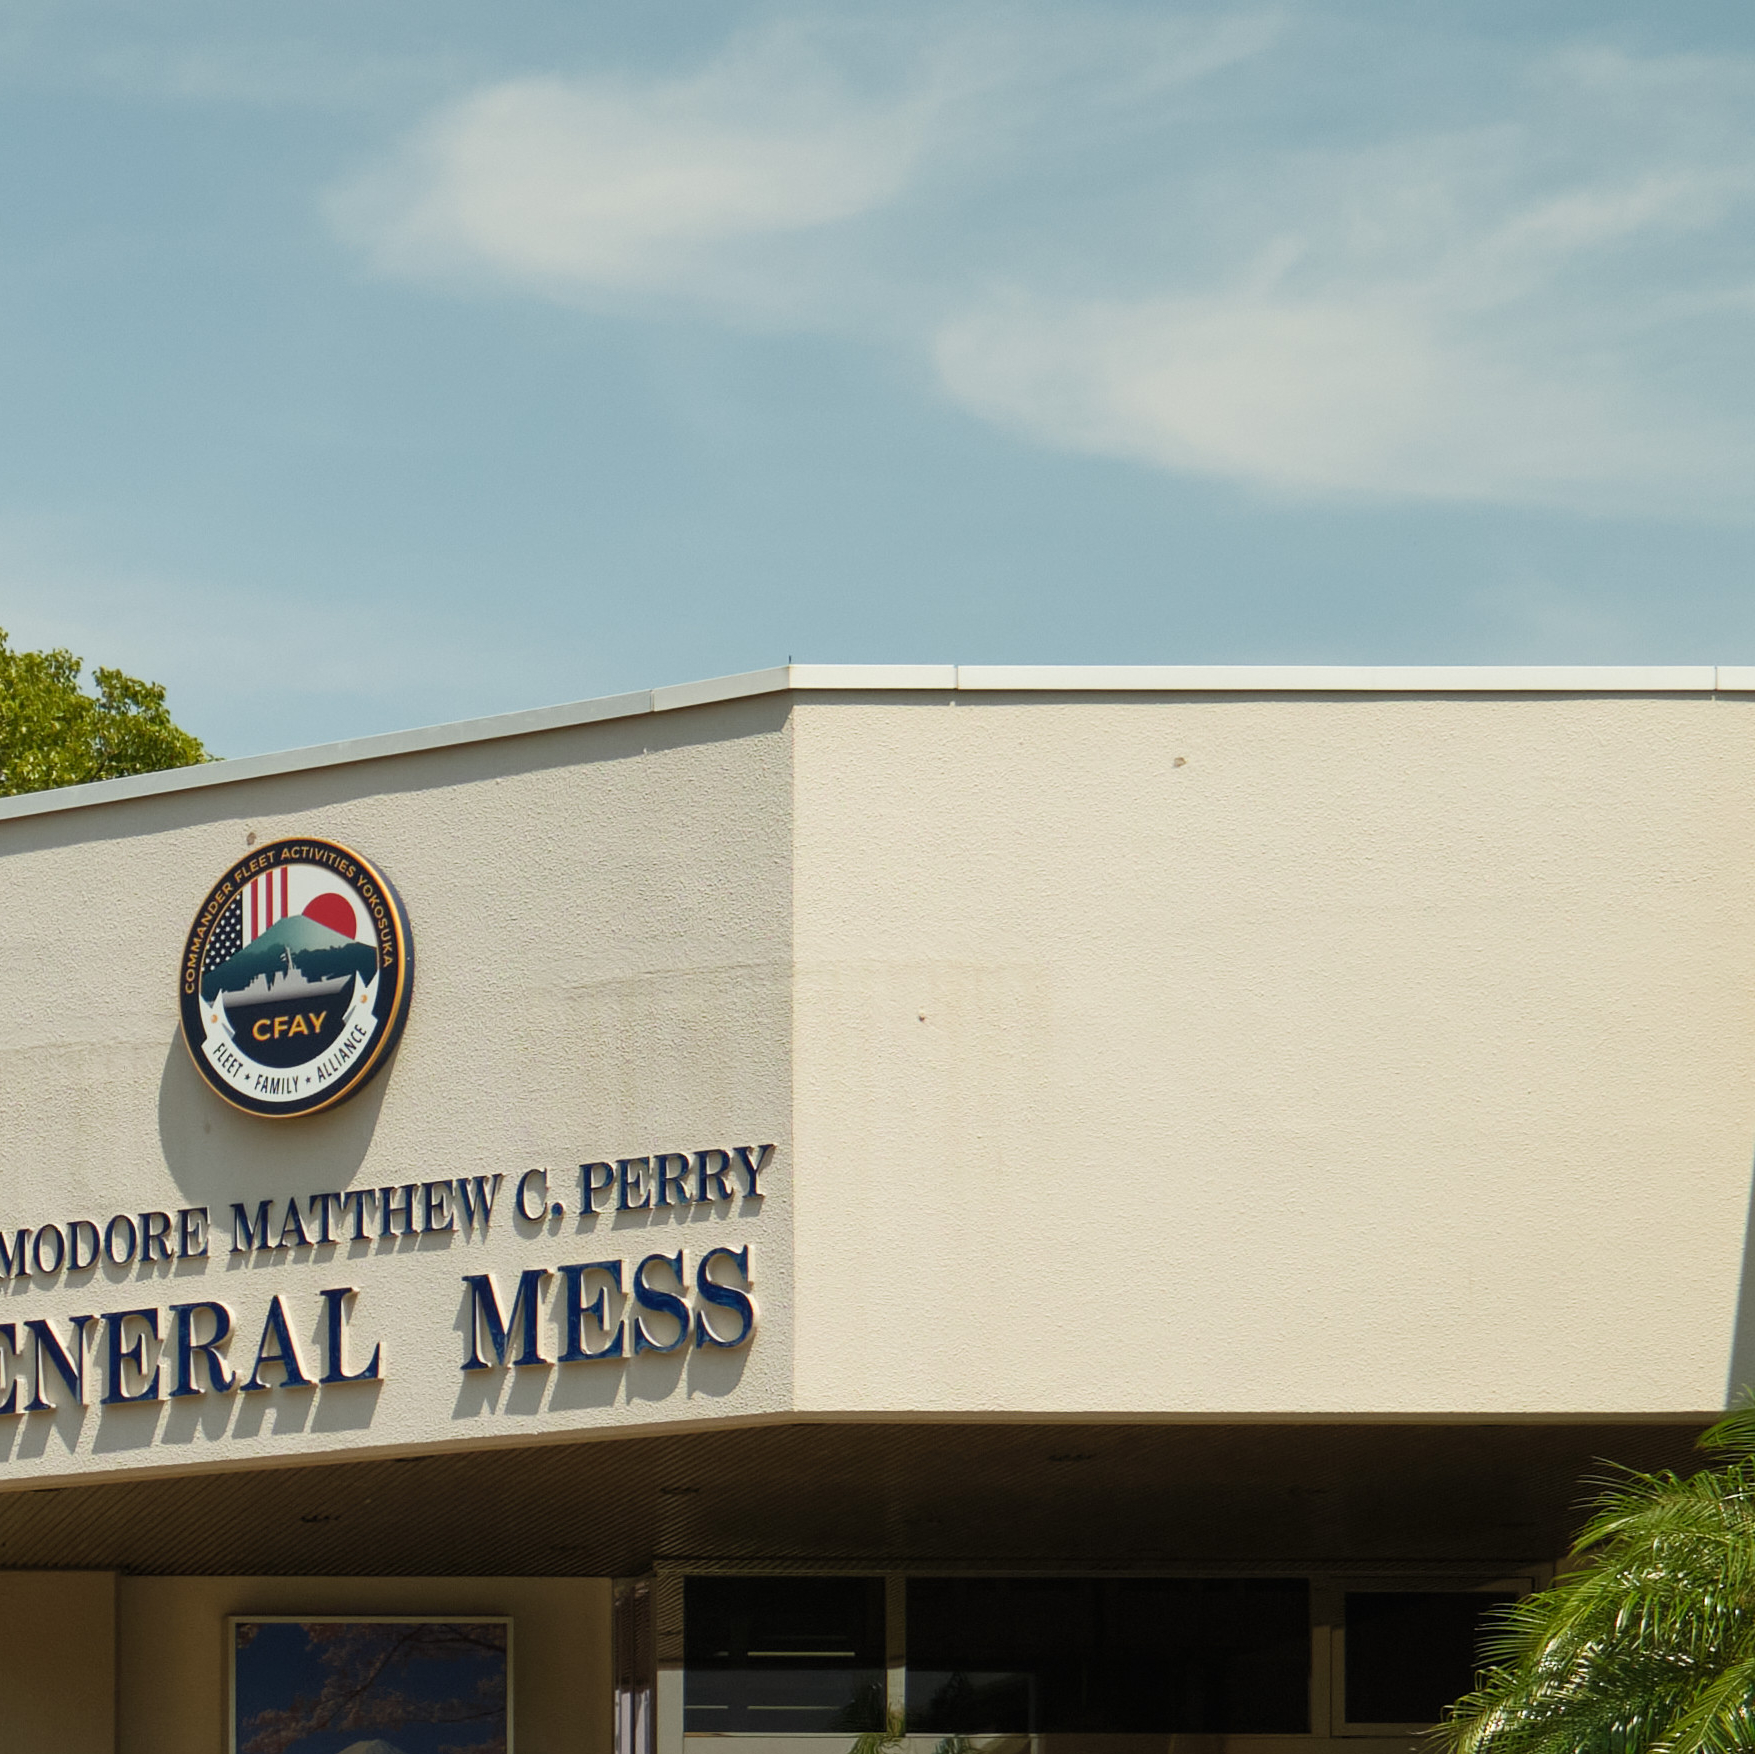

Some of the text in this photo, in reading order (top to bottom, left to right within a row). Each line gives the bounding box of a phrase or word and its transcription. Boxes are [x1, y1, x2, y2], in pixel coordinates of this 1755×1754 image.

[185, 846, 393, 993] COMMANDER FLEET ACTIVITIES YOKOSUKA
[213, 1024, 367, 1095] FLEET FAMILY ALLIANCE
[252, 1011, 327, 1041] CFAY
[229, 1173, 505, 1253] MATTHEW
[516, 1168, 563, 1222] C.
[579, 1144, 776, 1216] PERRY
[460, 1244, 760, 1371] MESS
